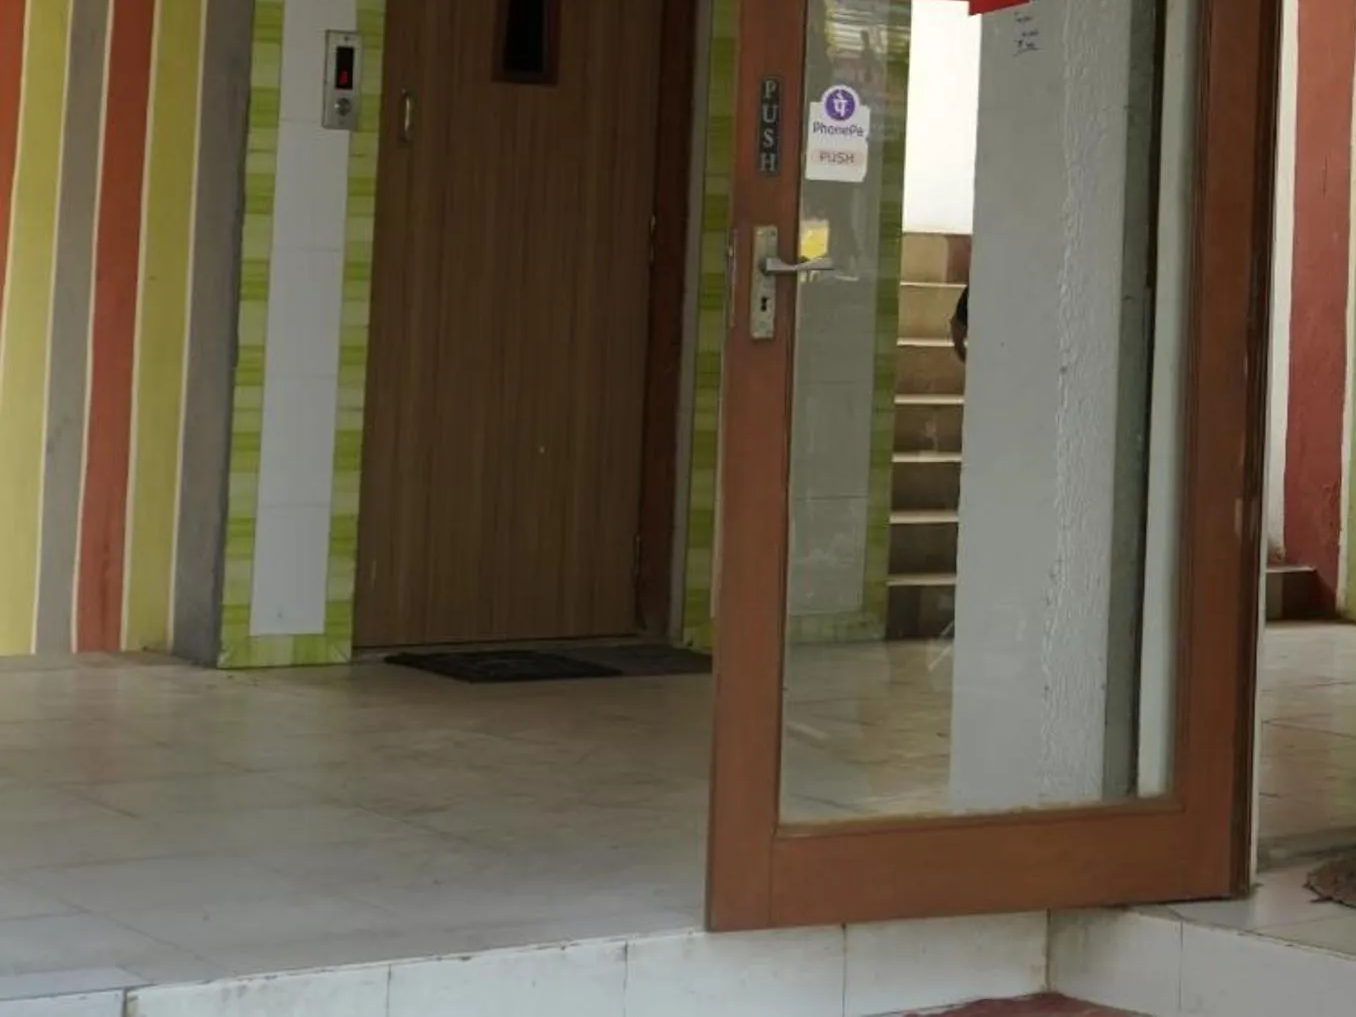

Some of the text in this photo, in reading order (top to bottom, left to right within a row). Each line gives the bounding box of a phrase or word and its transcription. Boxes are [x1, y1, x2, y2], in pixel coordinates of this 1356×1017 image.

[760, 79, 779, 172] PUSH
[812, 121, 864, 137] PhonePe
[819, 150, 855, 164] PUSH
